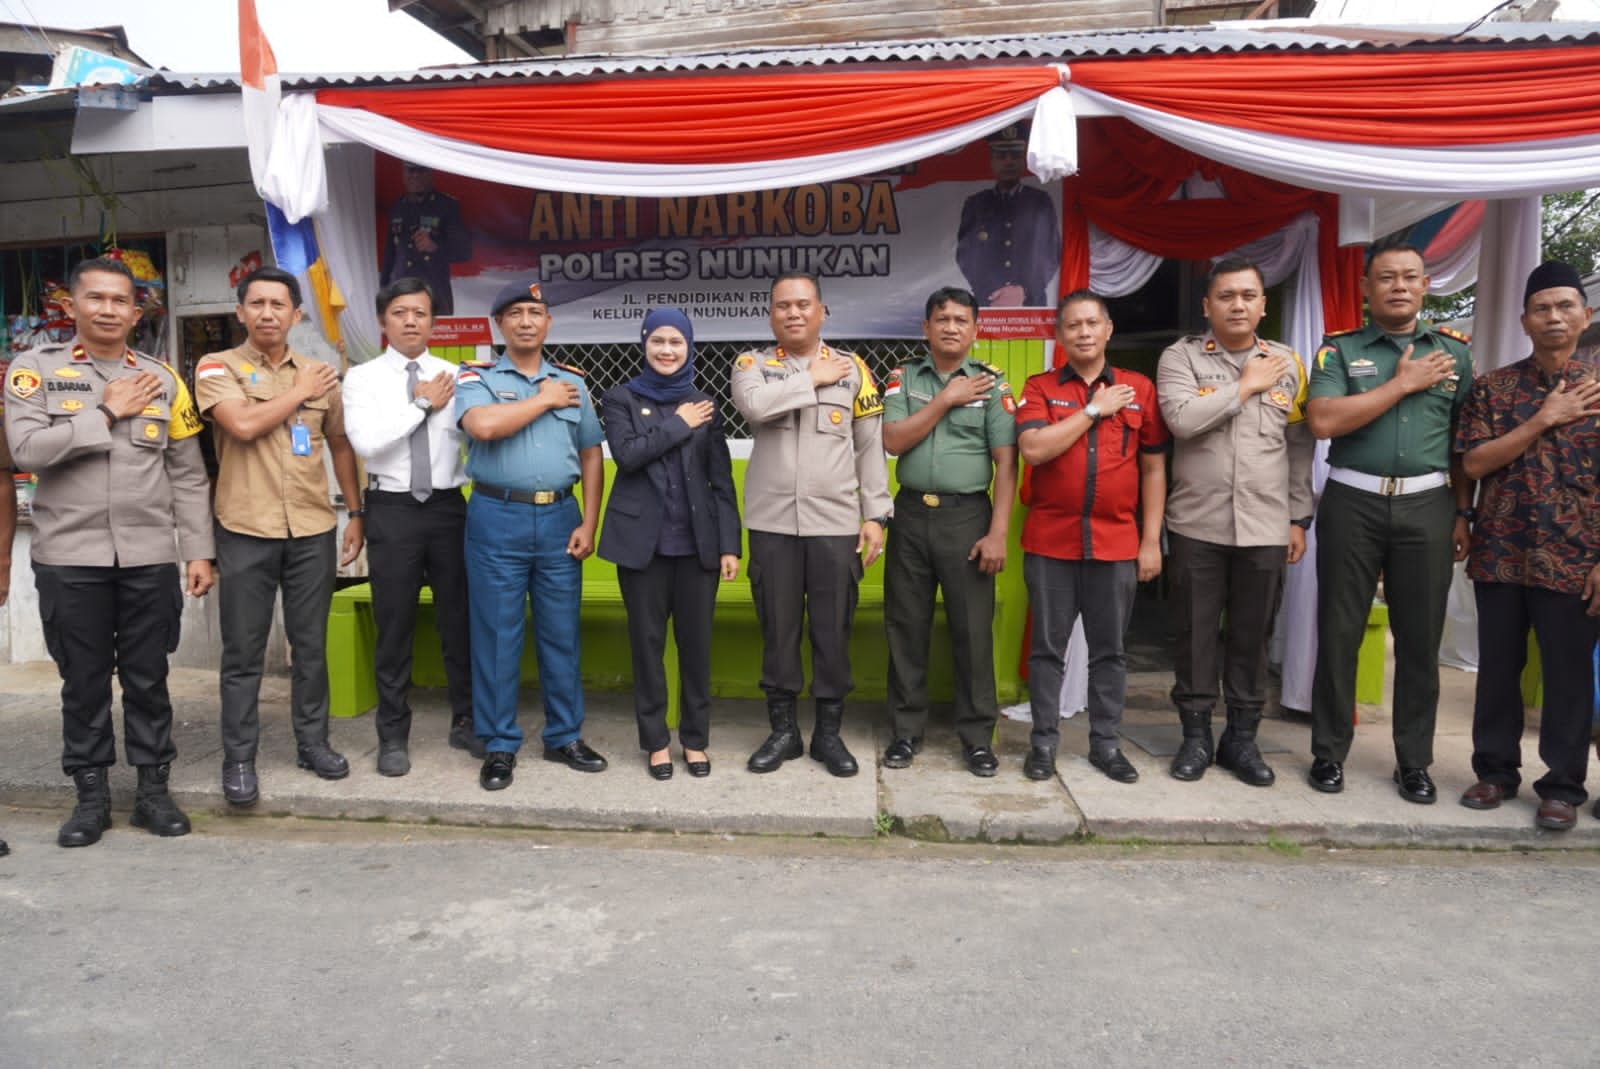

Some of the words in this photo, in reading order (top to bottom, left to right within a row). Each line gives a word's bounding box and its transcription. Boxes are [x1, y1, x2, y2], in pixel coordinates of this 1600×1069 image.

[529, 190, 638, 241] ANTI
[657, 181, 900, 239] NARKOBA
[539, 249, 690, 281] POLRES
[700, 245, 890, 280] NUNUKAN
[622, 293, 641, 305] JL.
[647, 291, 743, 304] PENDIDIKAN
